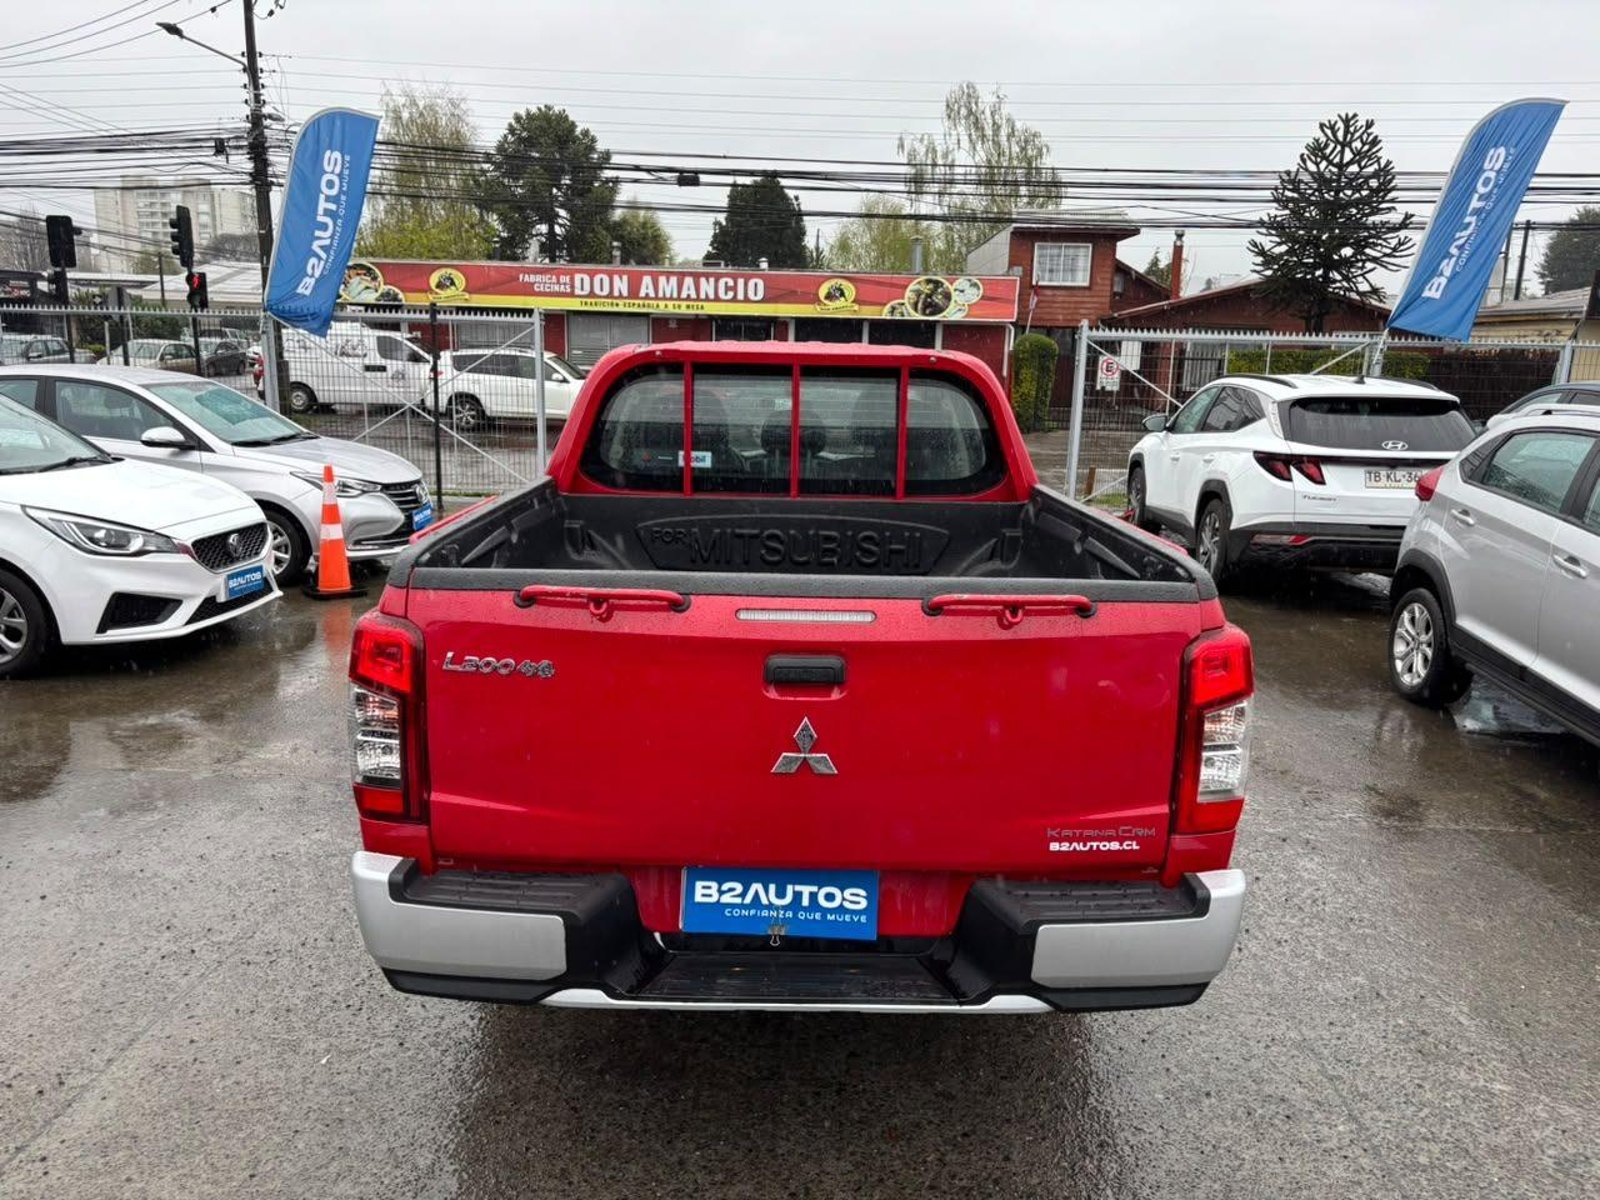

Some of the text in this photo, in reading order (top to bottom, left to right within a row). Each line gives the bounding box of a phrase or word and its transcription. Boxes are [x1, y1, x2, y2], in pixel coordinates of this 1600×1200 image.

[342, 154, 350, 191] MUEVE
[339, 194, 347, 215] QUE
[296, 150, 342, 297] B2AUTOS
[1421, 146, 1506, 299] B2AUTOS
[519, 274, 571, 283] FABRICA DE
[534, 283, 571, 293] CECINAS
[574, 273, 765, 301] DON AMANCIO
[652, 527, 923, 567] FOR MITSUBISHI
[442, 651, 516, 675] L200
[1048, 840, 1140, 851] B2AUTOS.CL
[693, 880, 868, 911] B2AUTOS
[724, 908, 868, 923] CONFIANZA QUE MUEVE
